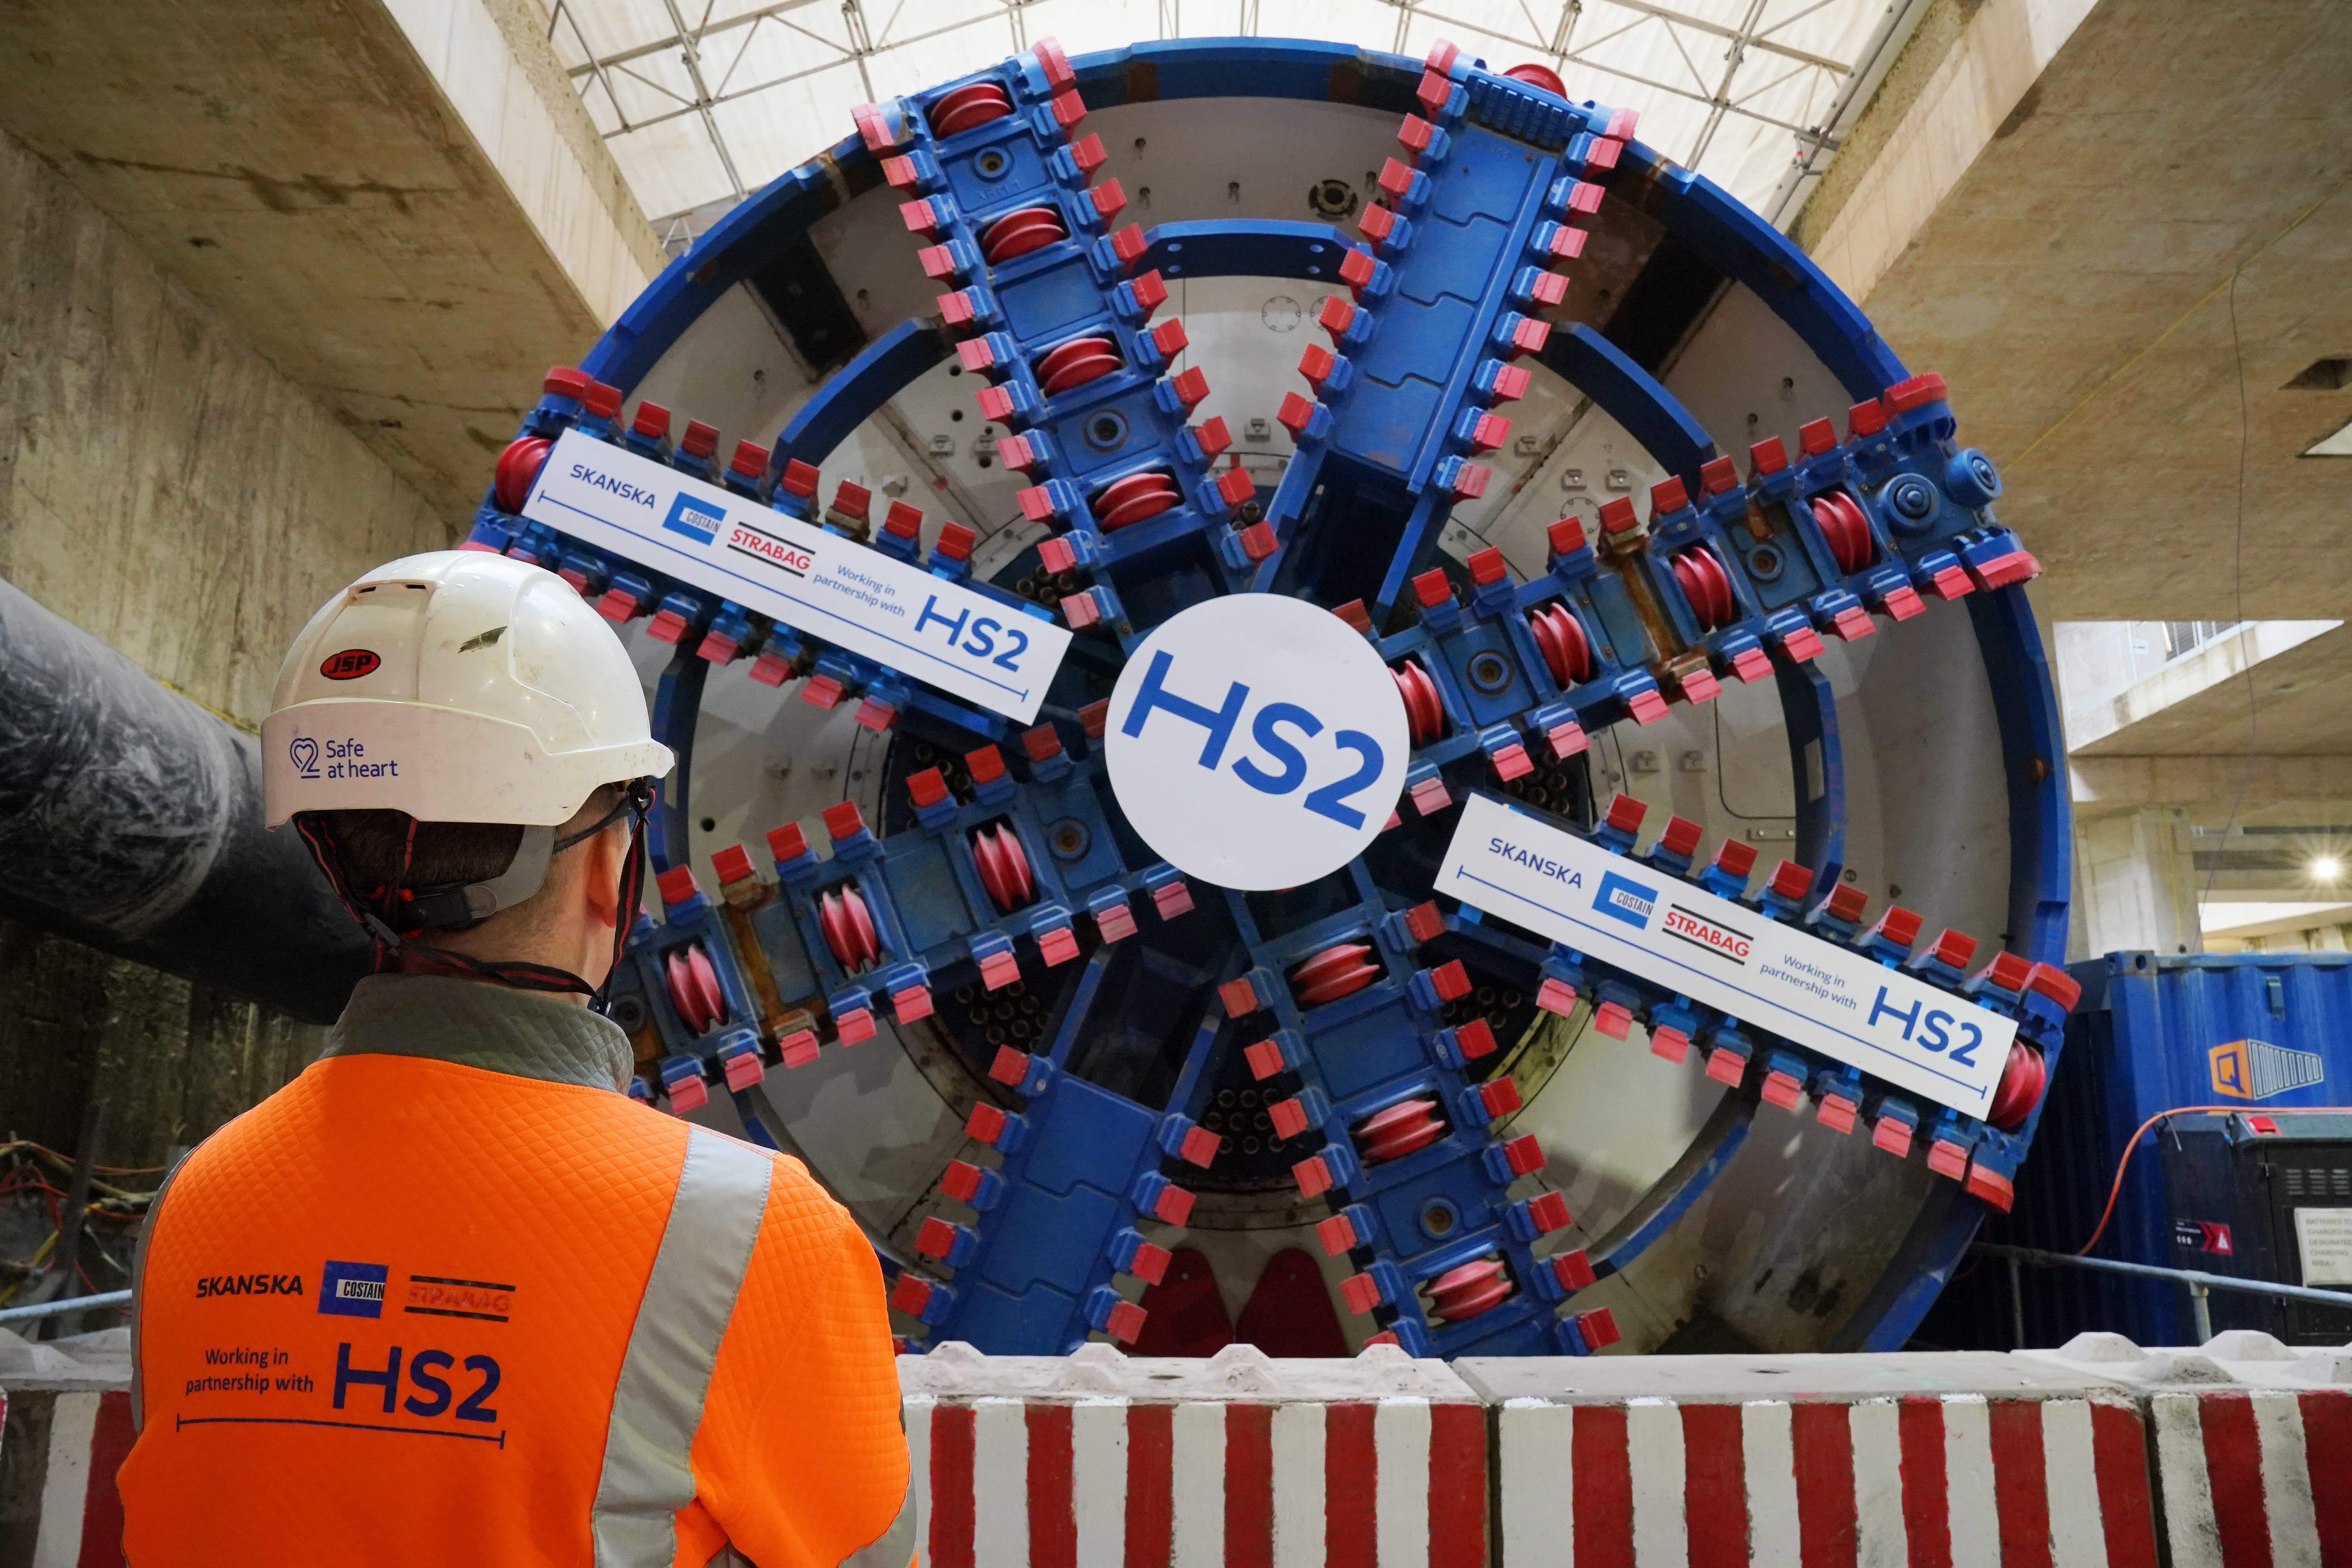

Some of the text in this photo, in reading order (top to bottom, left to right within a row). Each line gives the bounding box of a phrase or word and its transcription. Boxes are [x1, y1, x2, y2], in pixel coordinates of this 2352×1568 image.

[570, 464, 810, 569] SKANSKA COSTAIN STRABAG
[813, 574, 905, 617] partnership with
[837, 564, 895, 597] Working in
[915, 595, 1028, 672] HS2
[328, 655, 372, 674] JSP
[326, 738, 364, 758] Safe
[1121, 649, 1384, 830] HS2
[328, 759, 399, 778] at heart
[1488, 837, 1749, 956] SKANSKA COSTAIN STRABAG
[1760, 964, 1857, 1010] partnership with
[1784, 954, 1845, 988] Working in
[1868, 985, 1983, 1068] HS2
[196, 1274, 511, 1312] SKANSKA COSTAIN STRABAG
[205, 1347, 288, 1369] Working in
[186, 1373, 314, 1397] partnership with
[332, 1342, 501, 1423] HS2
